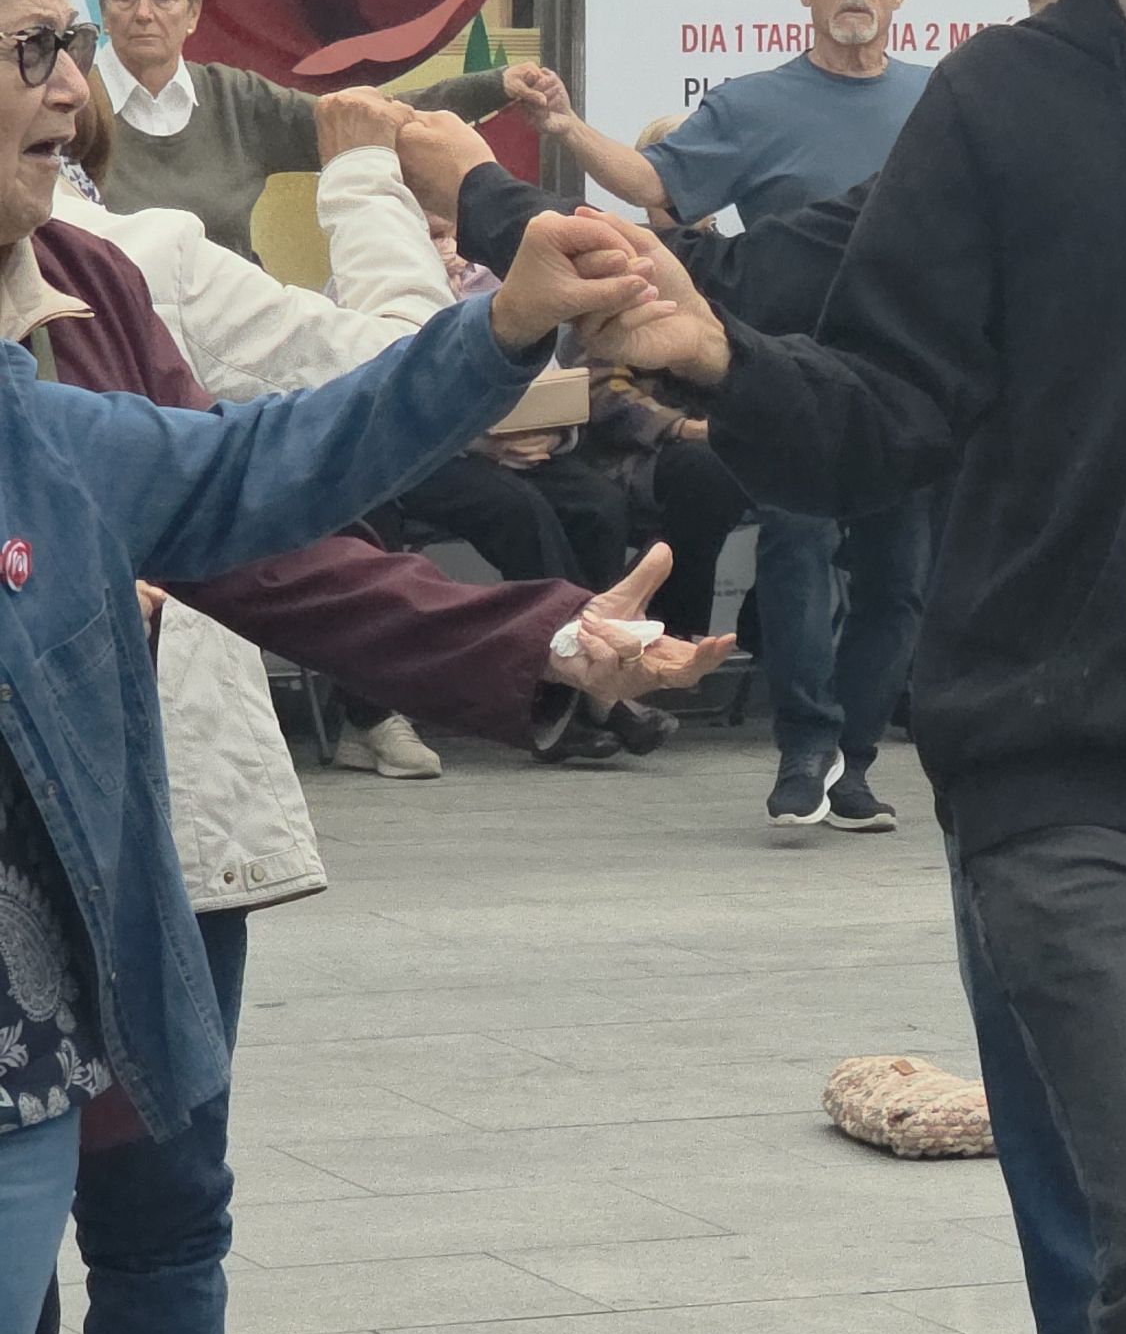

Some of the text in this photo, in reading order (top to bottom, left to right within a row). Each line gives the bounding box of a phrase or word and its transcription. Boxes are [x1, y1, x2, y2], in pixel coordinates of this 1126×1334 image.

[681, 24, 727, 53] DIA
[735, 24, 743, 53] 1
[892, 23, 917, 51] IA
[925, 23, 940, 51] 2
